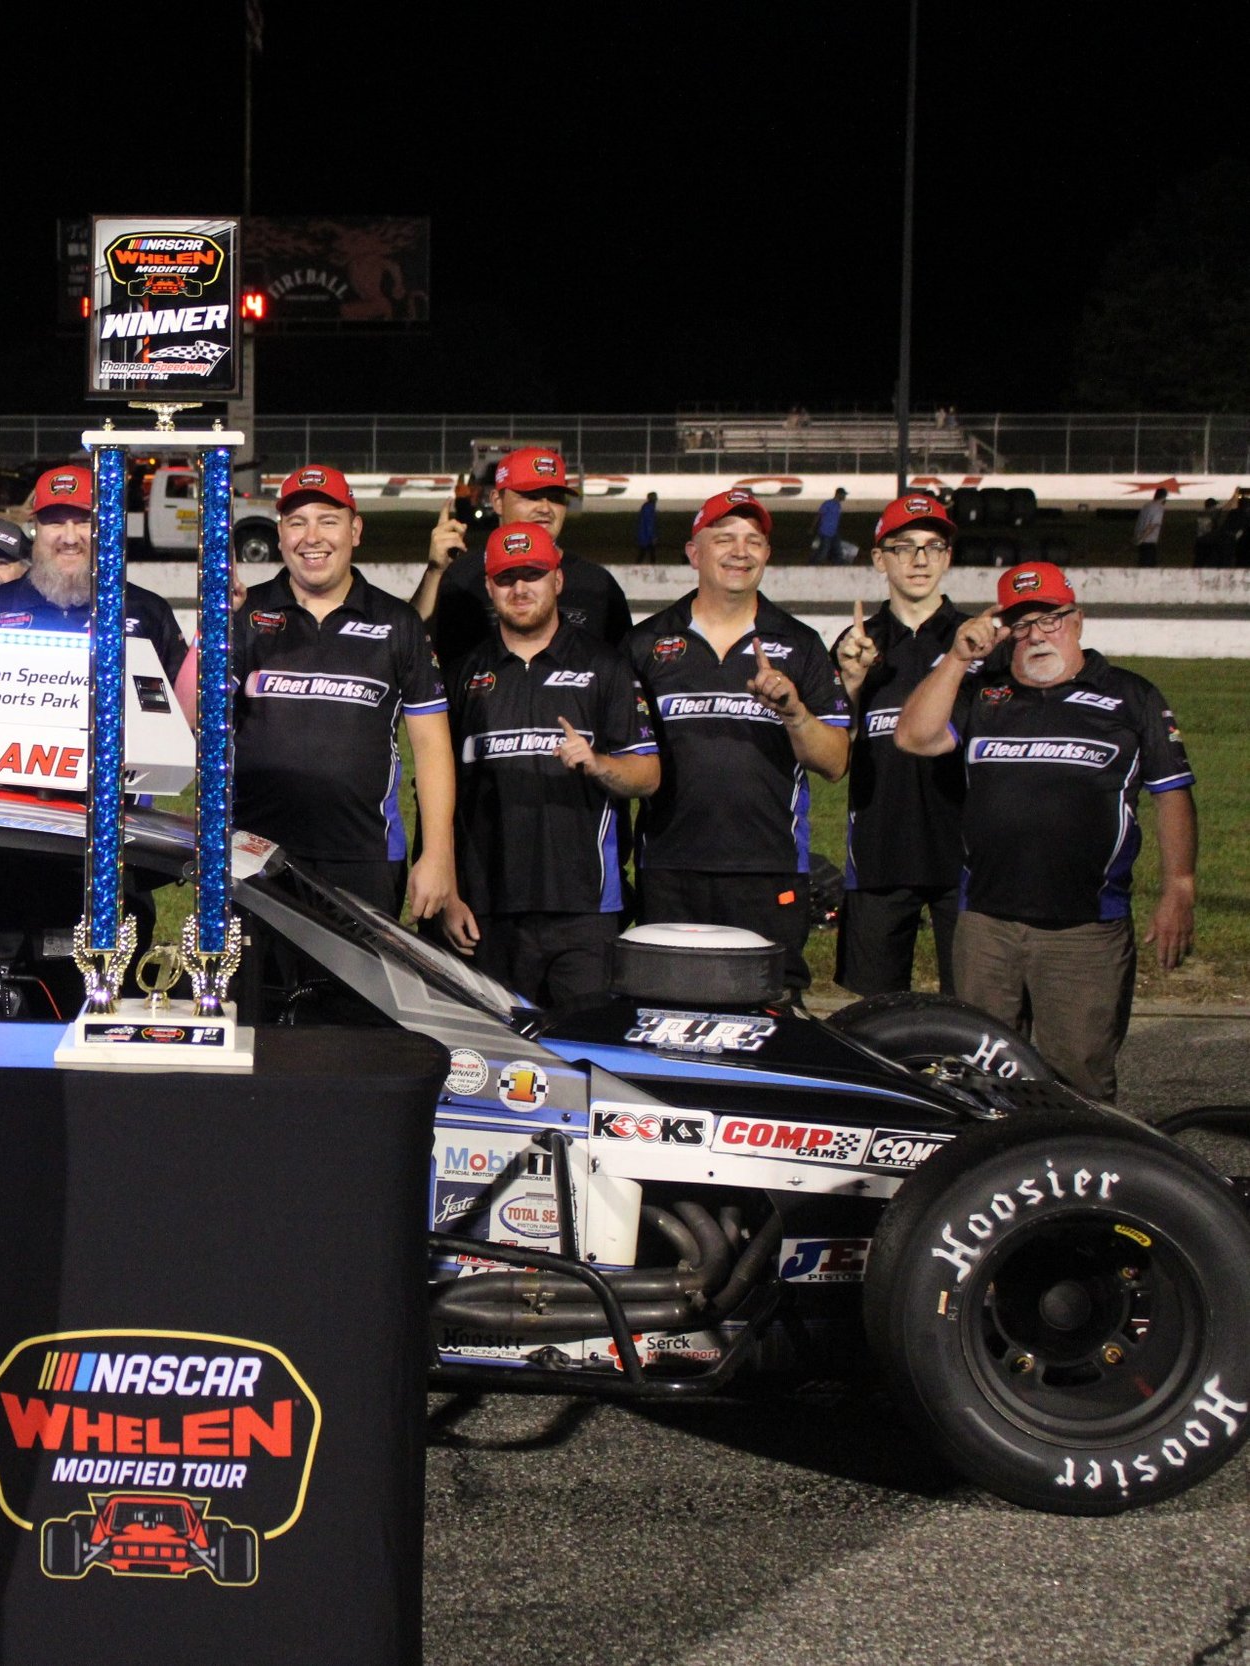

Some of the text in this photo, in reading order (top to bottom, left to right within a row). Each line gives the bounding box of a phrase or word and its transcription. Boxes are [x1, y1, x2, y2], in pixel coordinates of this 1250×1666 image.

[146, 239, 204, 251] NASCAR
[114, 249, 215, 265] WHELEN
[135, 265, 199, 273] MODIFIED
[101, 304, 230, 339] WINNER
[16, 668, 90, 689] Speedwa
[263, 675, 309, 693] Fleet
[310, 678, 365, 697] Works
[40, 693, 81, 709] Park
[669, 698, 711, 715] Fleet
[712, 697, 763, 716] Works
[1064, 690, 1123, 711] LFR
[869, 715, 899, 732] Flee
[982, 742, 1025, 758] Fleet
[1027, 742, 1086, 759] Works
[593, 1112, 705, 1146] KOOKS
[722, 1121, 834, 1149] COMP
[796, 1146, 848, 1160] CAMS
[872, 1138, 941, 1161] COM
[878, 1157, 921, 1167] GASKE
[444, 1169, 470, 1177] OFFICIAL
[507, 1207, 539, 1221] TOTAL
[932, 1159, 1120, 1283] Hoosier
[807, 1273, 865, 1282] PISTON
[647, 1335, 691, 1351] Serck
[647, 1348, 722, 1362] Motorsport
[91, 1353, 262, 1397] NASCAR
[0, 1391, 292, 1457] WHELEN
[1055, 1374, 1248, 1497] Hoosier
[52, 1457, 247, 1489] MODIFIED TOUR
